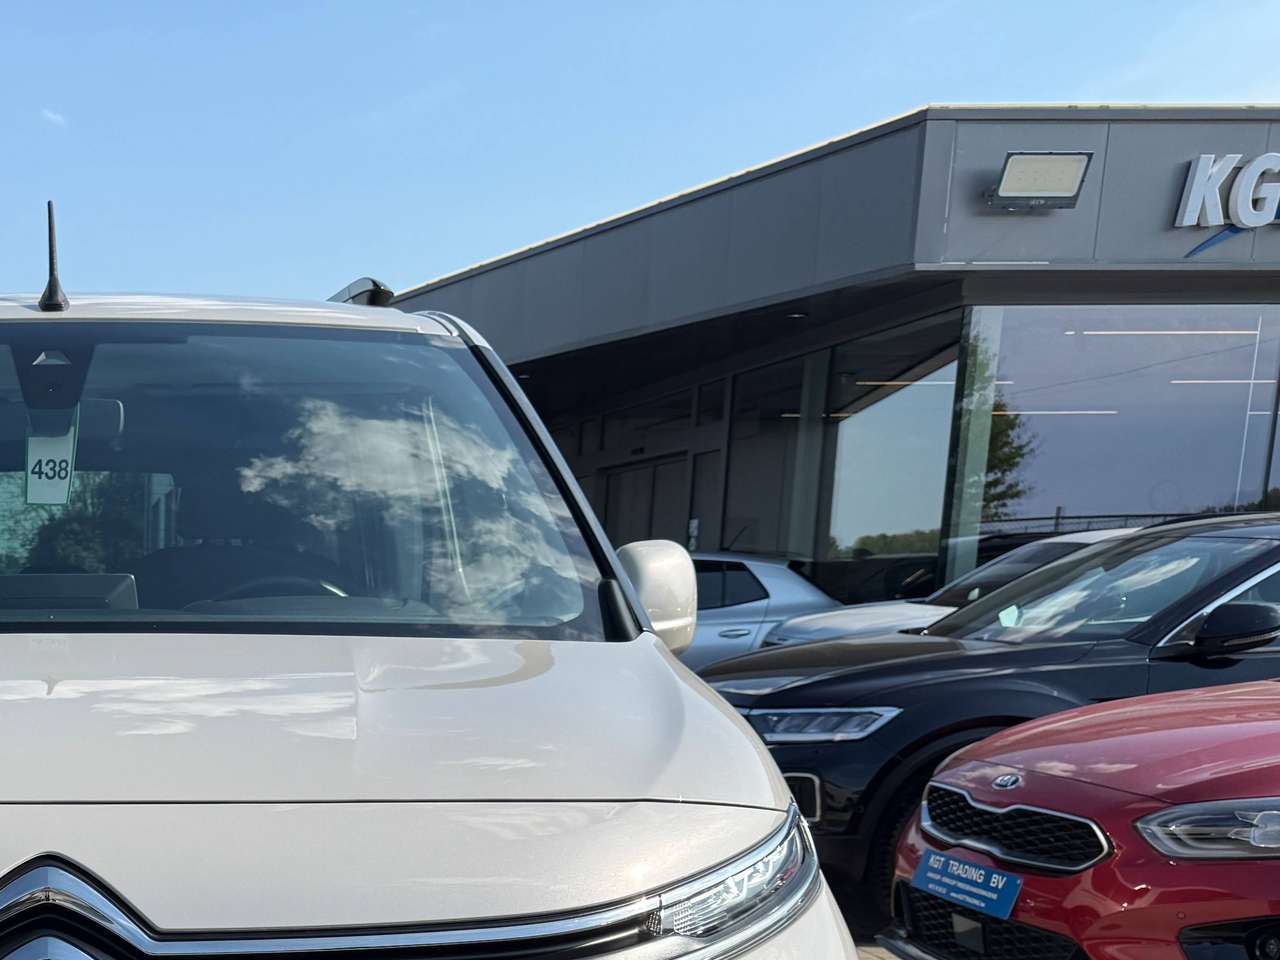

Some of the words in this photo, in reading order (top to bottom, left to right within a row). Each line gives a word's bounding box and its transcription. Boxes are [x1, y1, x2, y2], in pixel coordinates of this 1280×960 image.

[1175, 153, 1280, 228] KG
[31, 459, 69, 480] 438
[928, 854, 945, 870] KGT
[948, 860, 985, 883] TRADING
[990, 874, 1007, 889] BV
